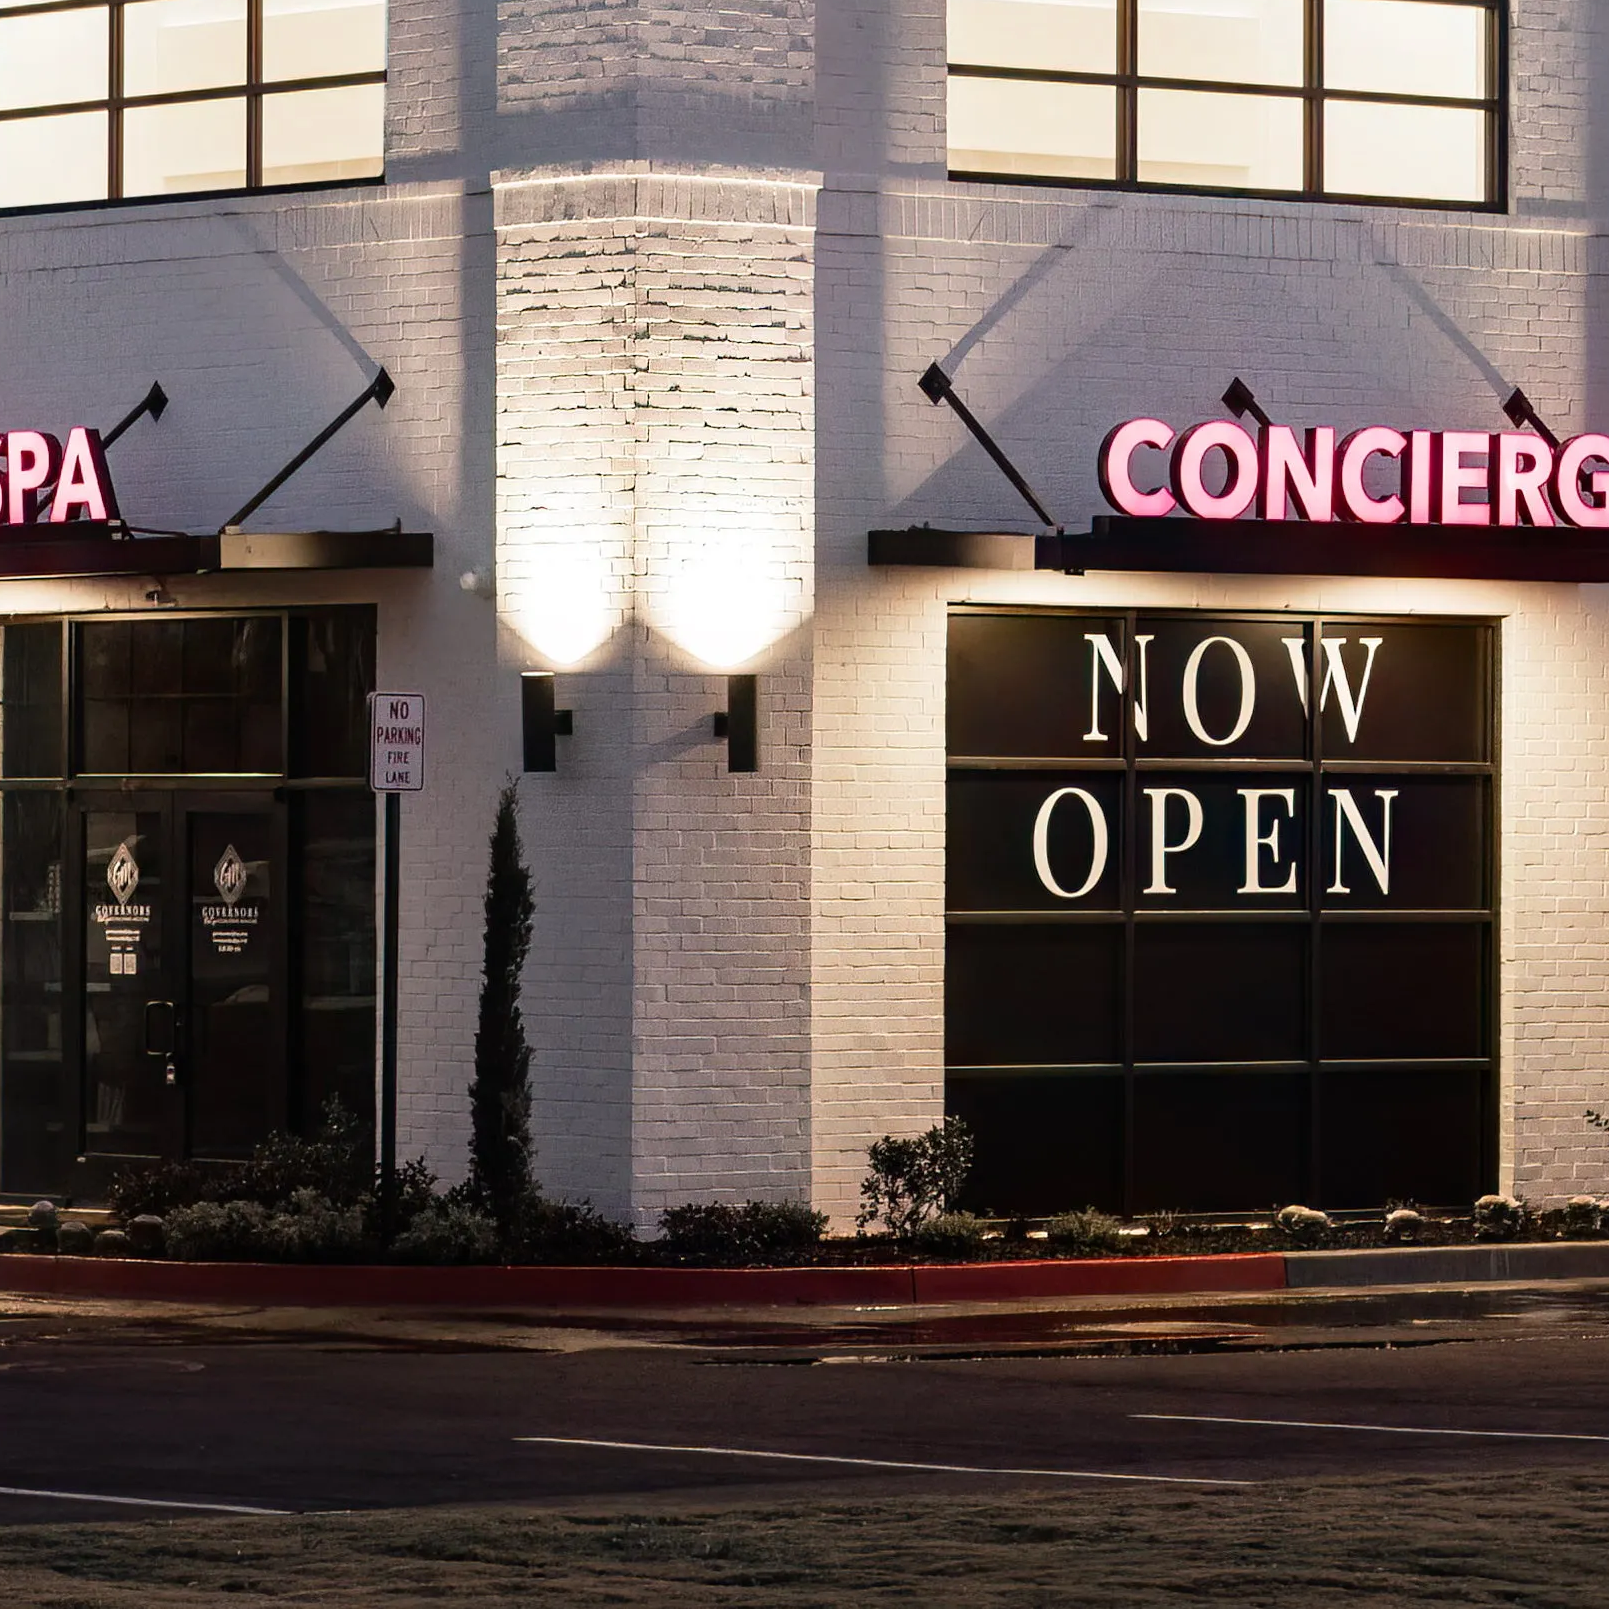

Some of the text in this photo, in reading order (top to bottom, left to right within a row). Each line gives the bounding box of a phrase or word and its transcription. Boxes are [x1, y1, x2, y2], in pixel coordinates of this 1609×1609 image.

[1082, 633, 1384, 746] NOW
[390, 701, 410, 720] NO
[376, 727, 422, 746] PARKING
[387, 751, 410, 765] FIRE
[385, 771, 411, 784] LANE
[1032, 787, 1399, 898] OPEN
